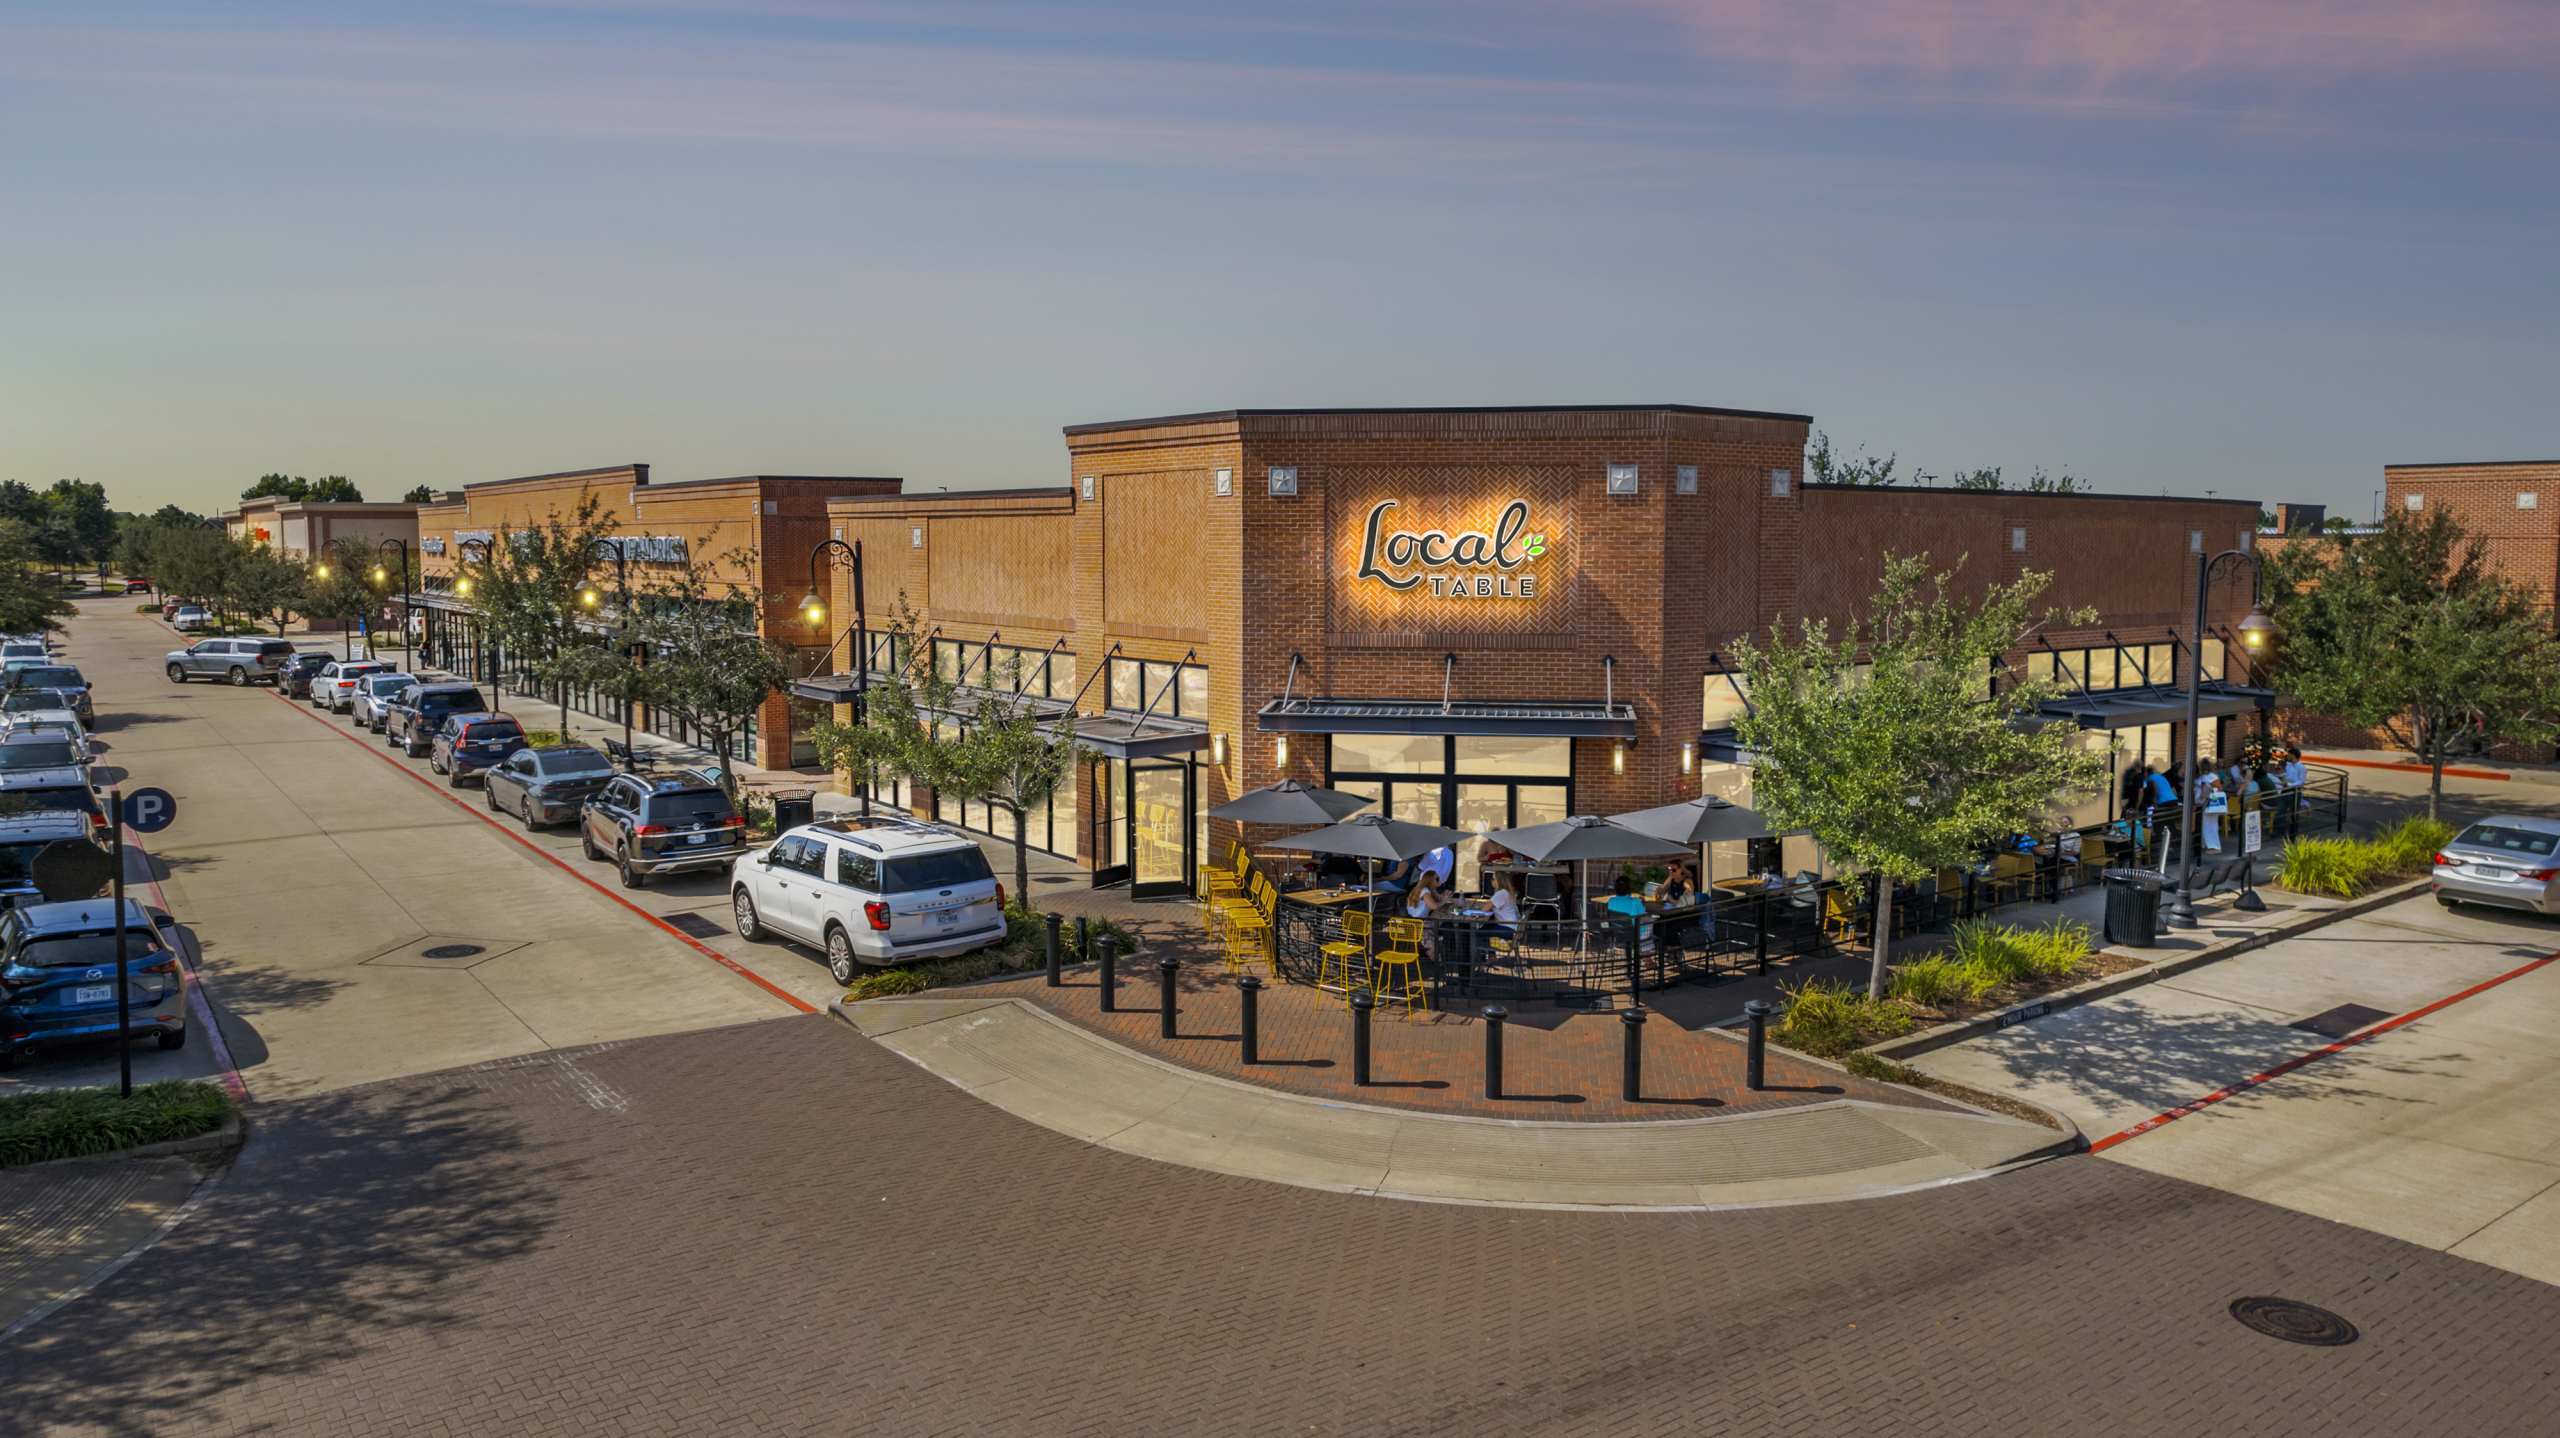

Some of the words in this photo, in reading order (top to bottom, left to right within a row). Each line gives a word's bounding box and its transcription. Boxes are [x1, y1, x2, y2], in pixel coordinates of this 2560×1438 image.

[1358, 501, 1527, 589] Local
[1430, 576, 1534, 597] TABLE
[136, 795, 164, 825] P
